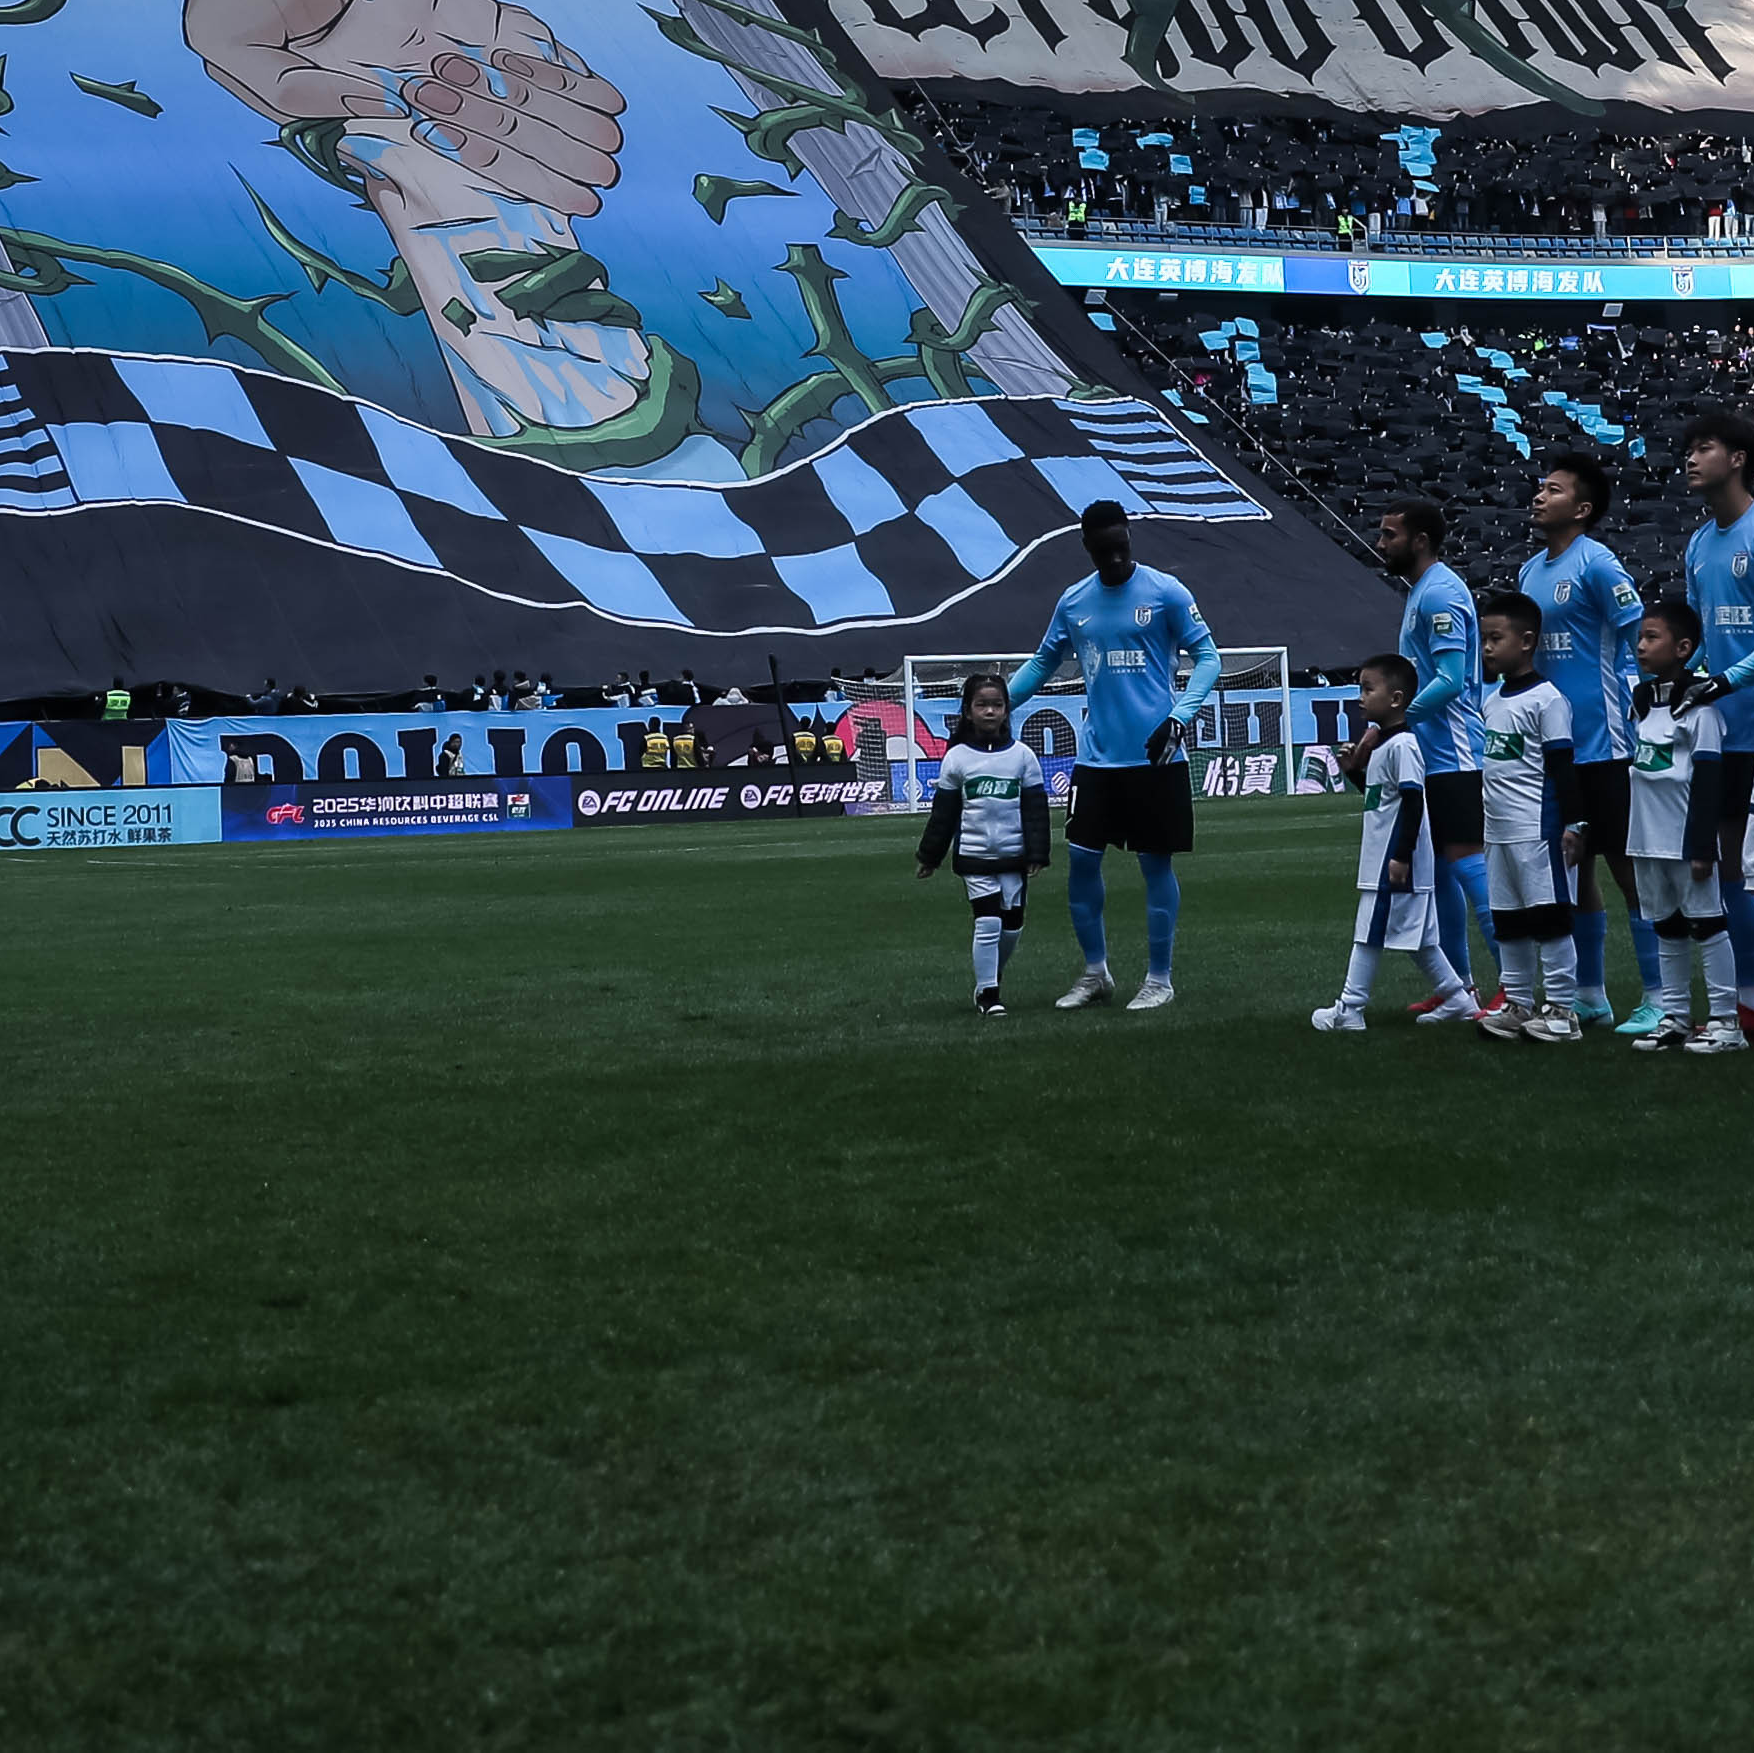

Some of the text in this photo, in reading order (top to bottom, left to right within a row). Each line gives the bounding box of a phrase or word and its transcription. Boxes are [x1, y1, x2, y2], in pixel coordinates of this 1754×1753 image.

[1105, 256, 1284, 287] 大连英博海发队
[1434, 268, 1606, 294] 大连英博海发队
[1204, 753, 1279, 798] 怡寶
[312, 793, 499, 814] 2025华润饮料中超联赛
[601, 790, 634, 813] FC
[637, 787, 730, 812] ONLINE
[761, 784, 794, 807] FC
[799, 781, 886, 805] 足球世界
[47, 803, 172, 827] SINCE 2011
[314, 813, 499, 828] 2025 CHINA RESOURCES BEVERAGE CSL
[47, 827, 172, 846] 天然苏打水 鲜果茶
